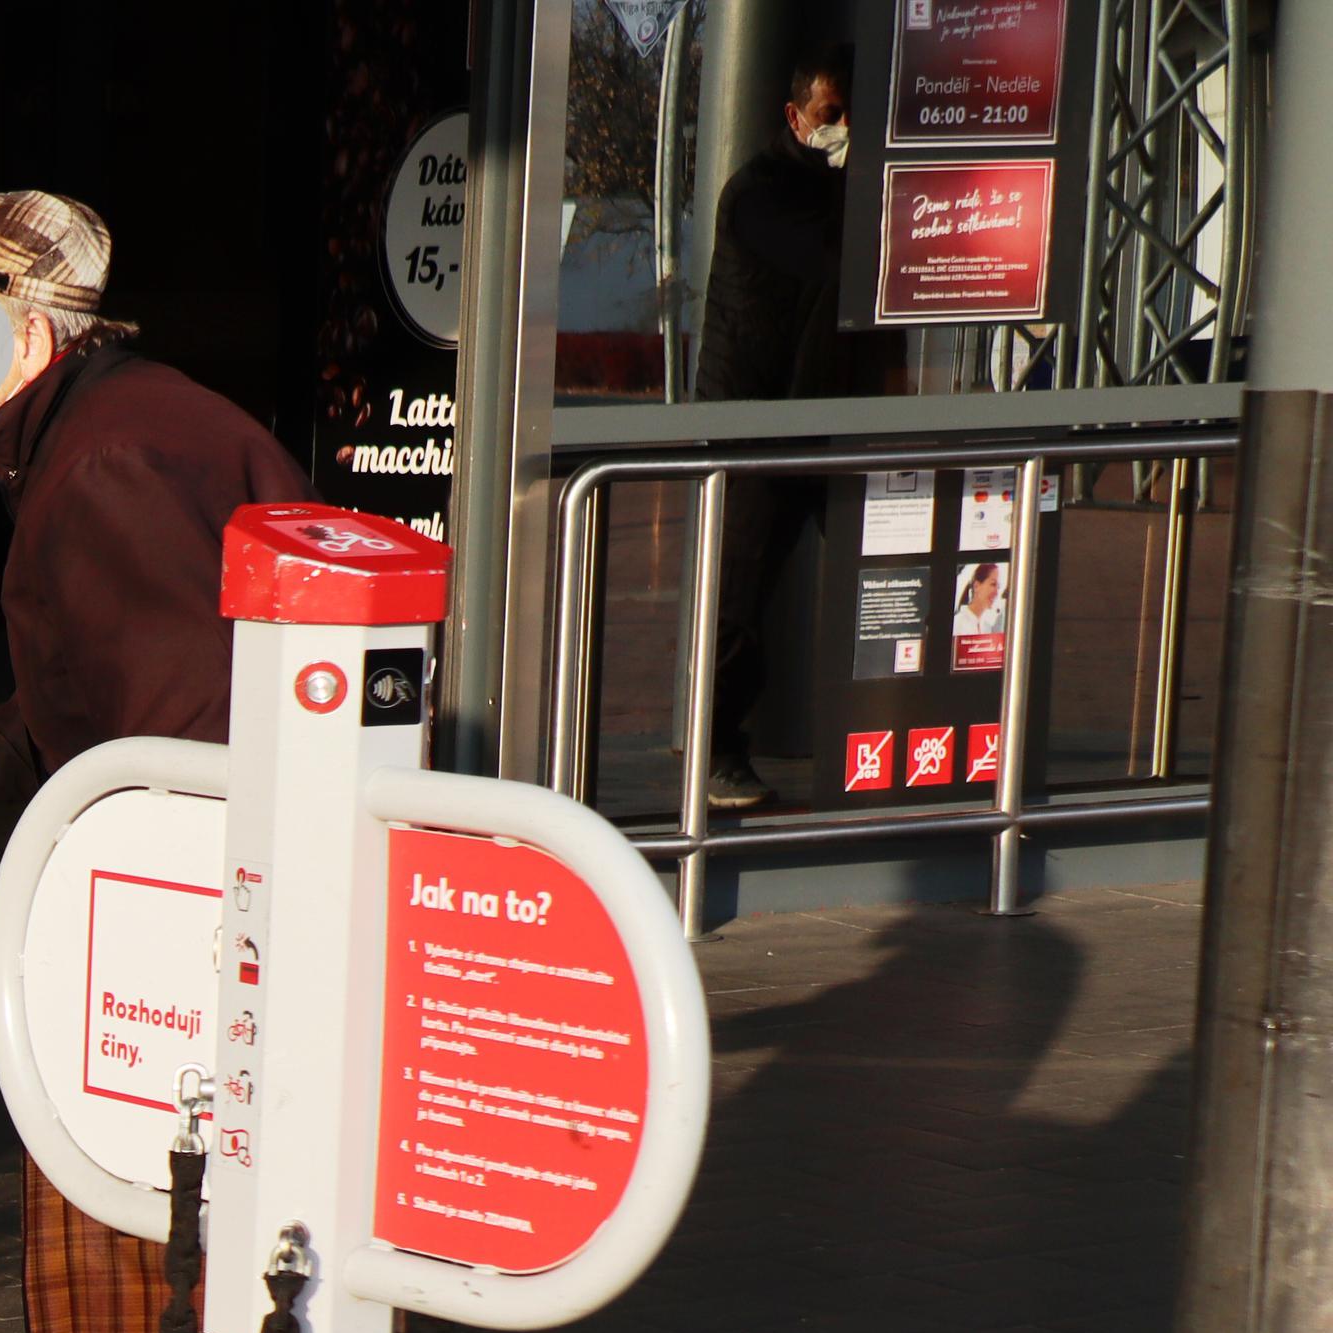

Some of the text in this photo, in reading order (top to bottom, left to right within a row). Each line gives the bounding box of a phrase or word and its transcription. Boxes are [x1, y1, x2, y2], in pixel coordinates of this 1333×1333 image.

[986, 76, 1041, 93] Neděle
[919, 106, 966, 124] 06:00
[982, 105, 1029, 124] 21:00
[419, 154, 467, 186] Dát
[912, 194, 951, 222] Jsme
[989, 188, 1004, 206] že
[1008, 191, 1023, 204] se
[911, 205, 1023, 240] osobně setkáváme!
[405, 246, 459, 291] 15,-
[352, 437, 454, 476] macchi
[410, 873, 553, 926] Jak na to?
[100, 991, 202, 1040] Rozhodují
[100, 1032, 142, 1065] činy.
